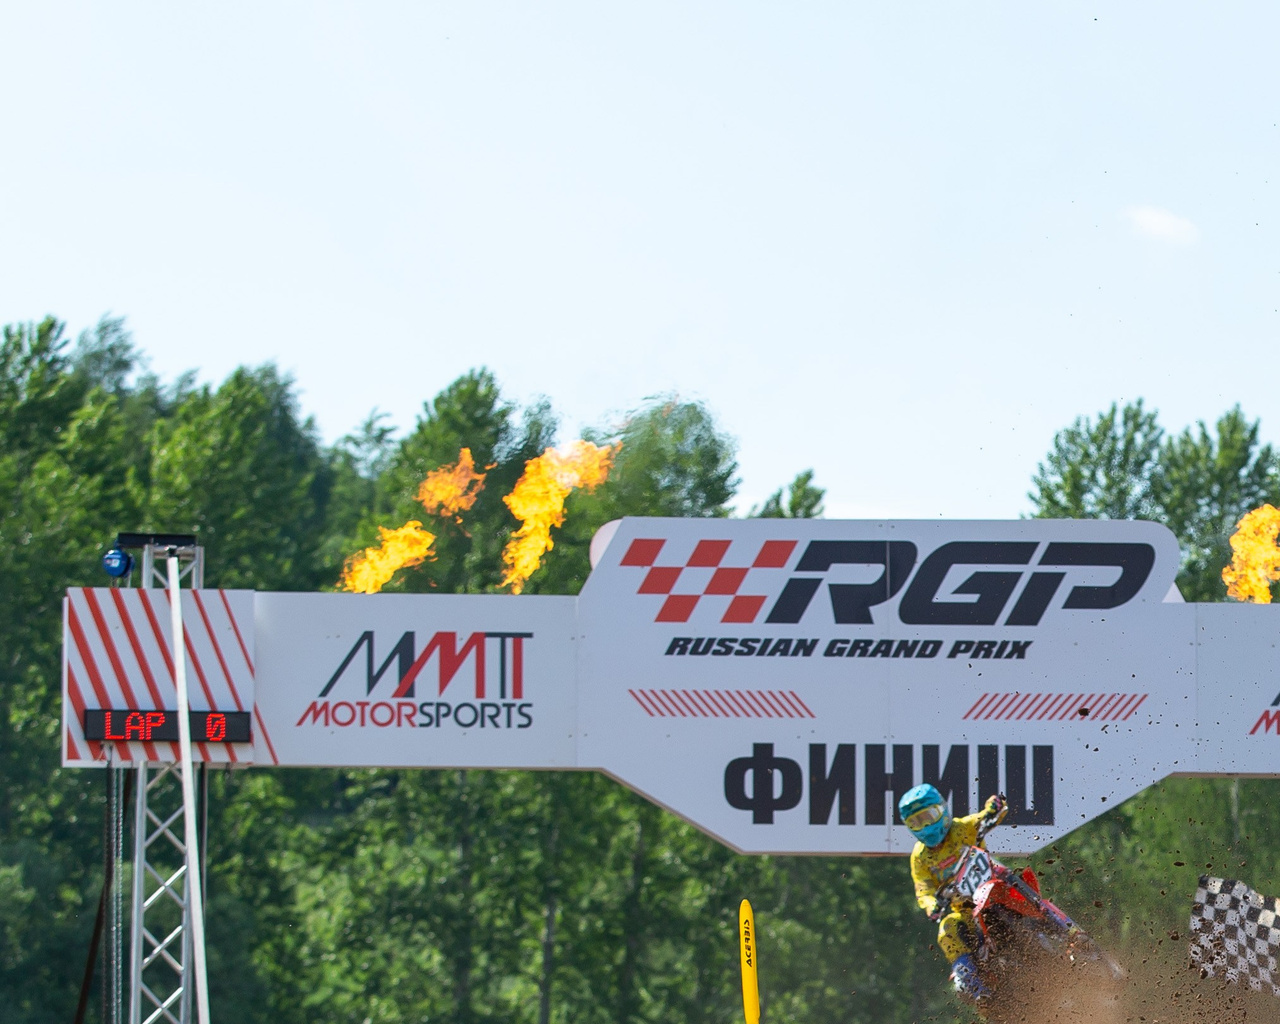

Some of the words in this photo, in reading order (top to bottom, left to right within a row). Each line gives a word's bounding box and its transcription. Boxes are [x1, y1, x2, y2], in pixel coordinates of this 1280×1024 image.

[764, 540, 1156, 626] RGP
[665, 637, 819, 656] RUSSIAN
[823, 638, 945, 658] GRAND
[947, 640, 1033, 660] PRIX
[104, 711, 166, 740] LAP
[206, 713, 226, 741] 0
[295, 701, 533, 729] MOTORSPORTS
[723, 743, 1055, 826] ФИНИШ
[743, 919, 753, 968] ACERBIS
